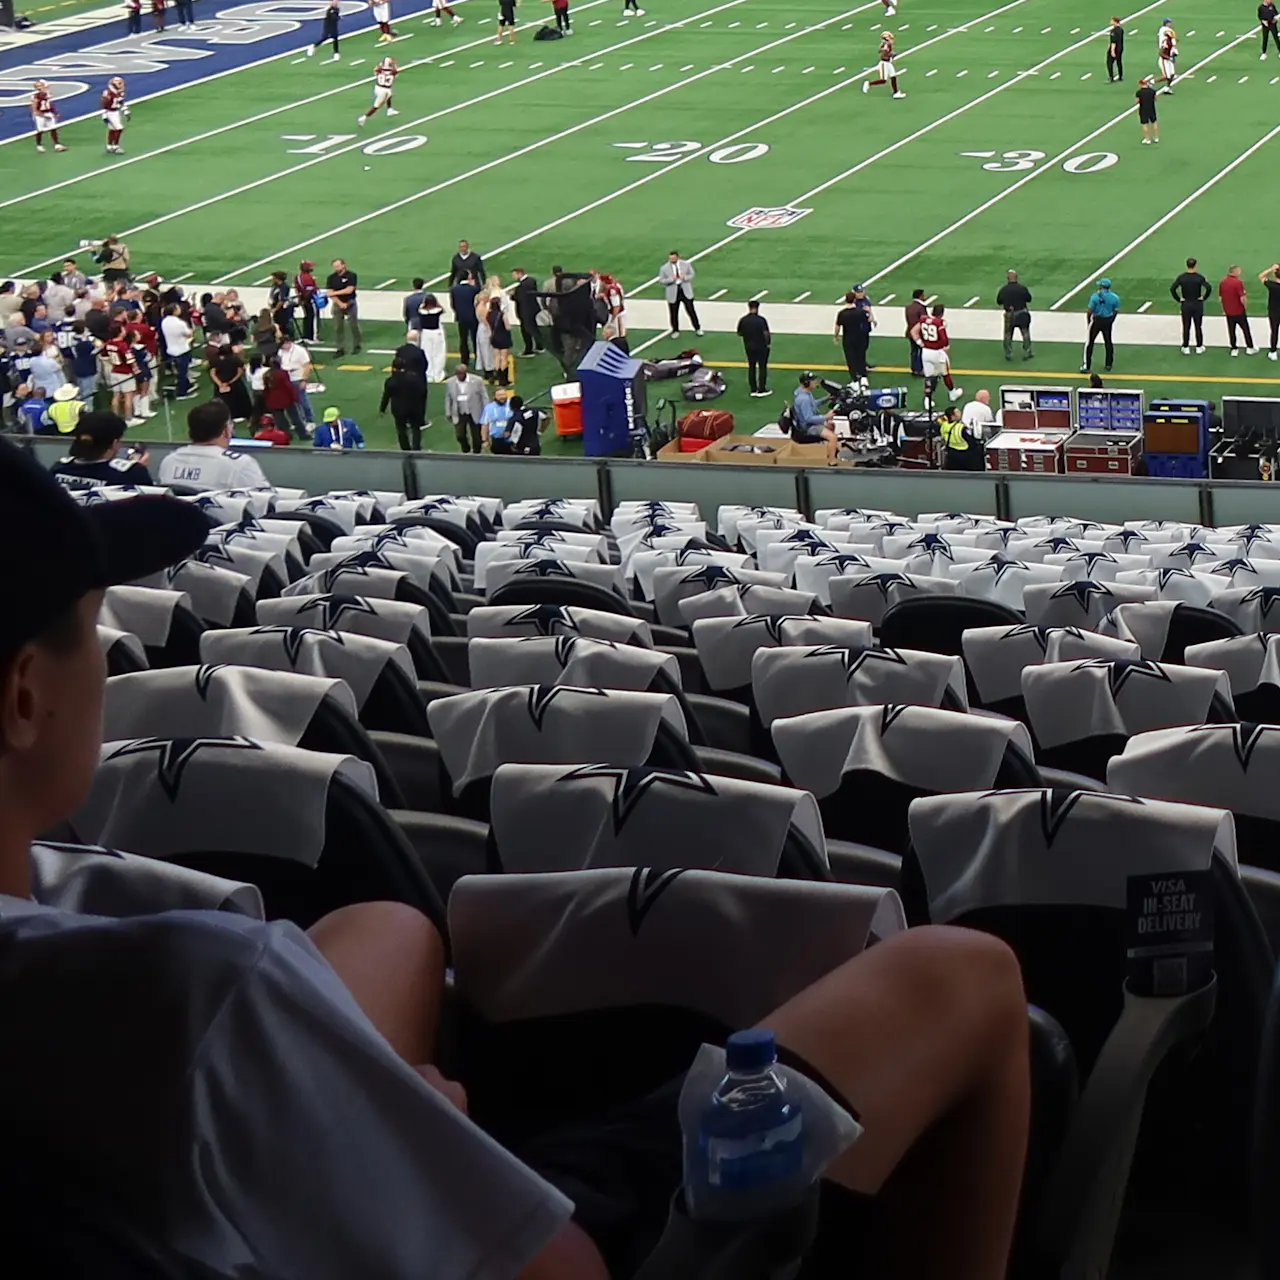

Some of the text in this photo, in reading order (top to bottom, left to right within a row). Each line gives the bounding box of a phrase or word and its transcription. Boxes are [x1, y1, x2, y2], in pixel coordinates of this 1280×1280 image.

[285, 134, 428, 155] 10
[625, 141, 770, 163] 20
[981, 150, 1120, 174] 30
[744, 214, 788, 226] NFL
[921, 322, 938, 343] 69
[173, 466, 202, 482] LAMB
[1151, 879, 1186, 894] VISA
[1143, 893, 1196, 915] IN-SEAT
[1137, 912, 1201, 935] DELIVERY
